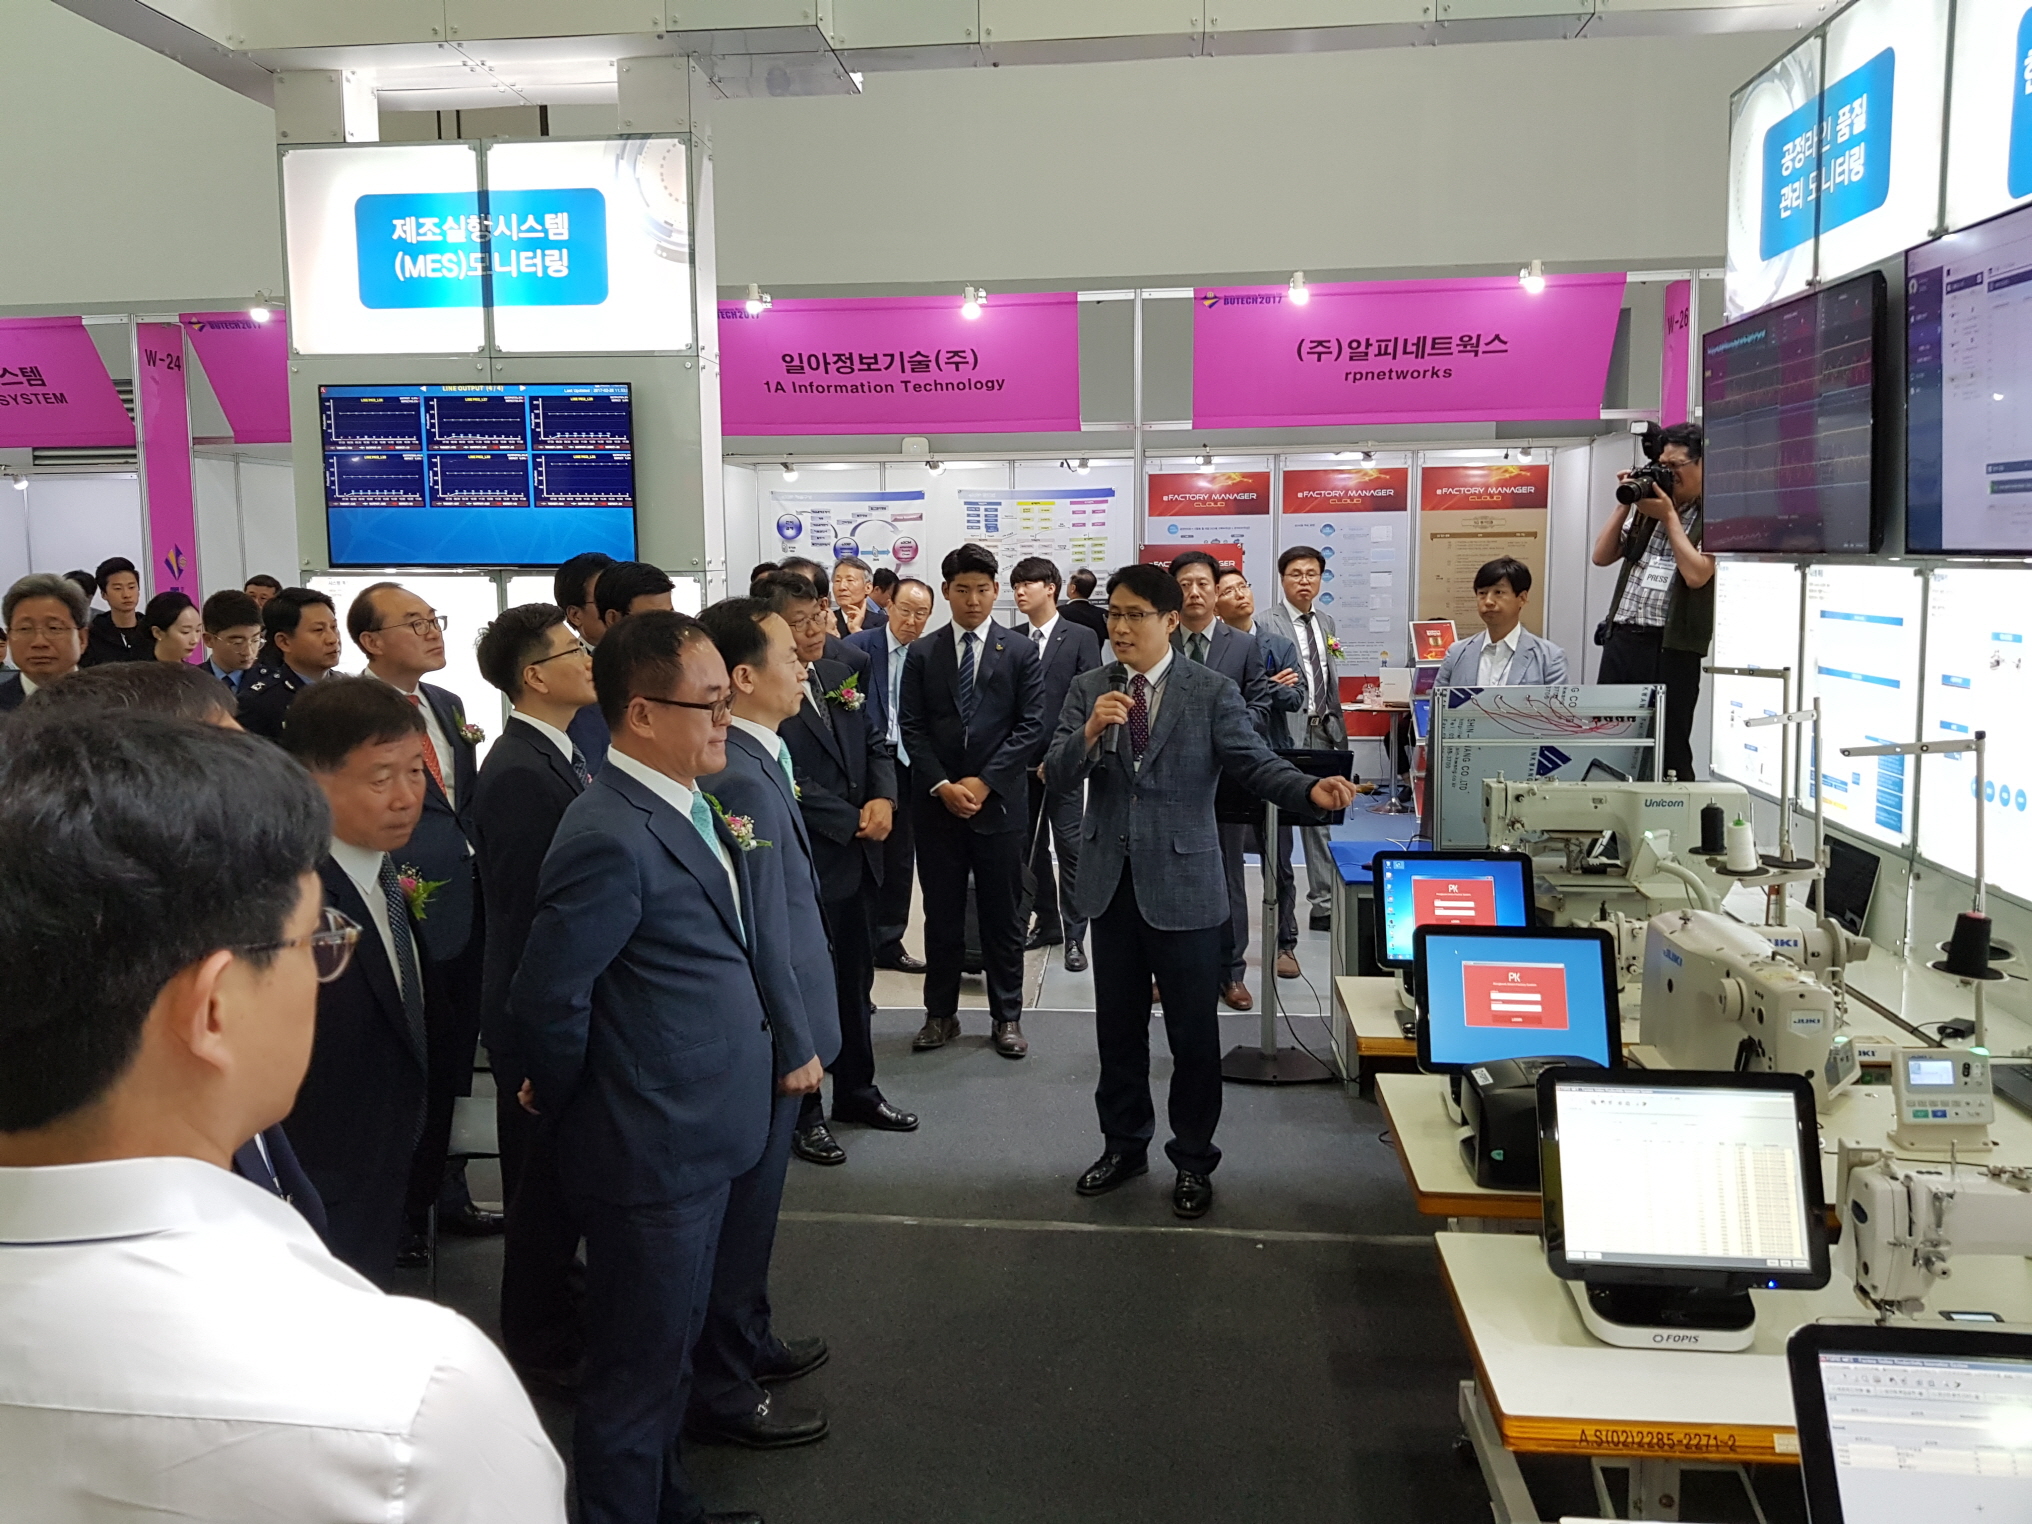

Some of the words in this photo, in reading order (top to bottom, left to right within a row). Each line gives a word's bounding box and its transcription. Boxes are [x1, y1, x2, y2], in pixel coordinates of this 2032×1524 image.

[1836, 93, 1867, 144] 품질
[1779, 176, 1804, 219] 관리
[1667, 307, 1689, 335] W-26
[1296, 333, 1509, 363] (주)알피네트웍스
[144, 348, 182, 372] W-24
[781, 348, 979, 375] 일아정보기술(주)
[1344, 366, 1453, 384] rpnetworks
[763, 380, 786, 394] 1A
[792, 380, 895, 395] Information
[900, 376, 1006, 393] Technology
[1163, 493, 1209, 501] eFACTORY
[1211, 492, 1257, 500] MANAGER
[1297, 489, 1345, 498] eFACTORY
[1347, 488, 1394, 497] MANAGER
[1436, 487, 1485, 495] eFACTORY
[1487, 486, 1535, 494] MANAGER
[1646, 573, 1669, 584] PRESS
[1644, 798, 1684, 808] Unicorn
[1663, 947, 1683, 968] JUKI
[1665, 1334, 1700, 1344] FOPIS
